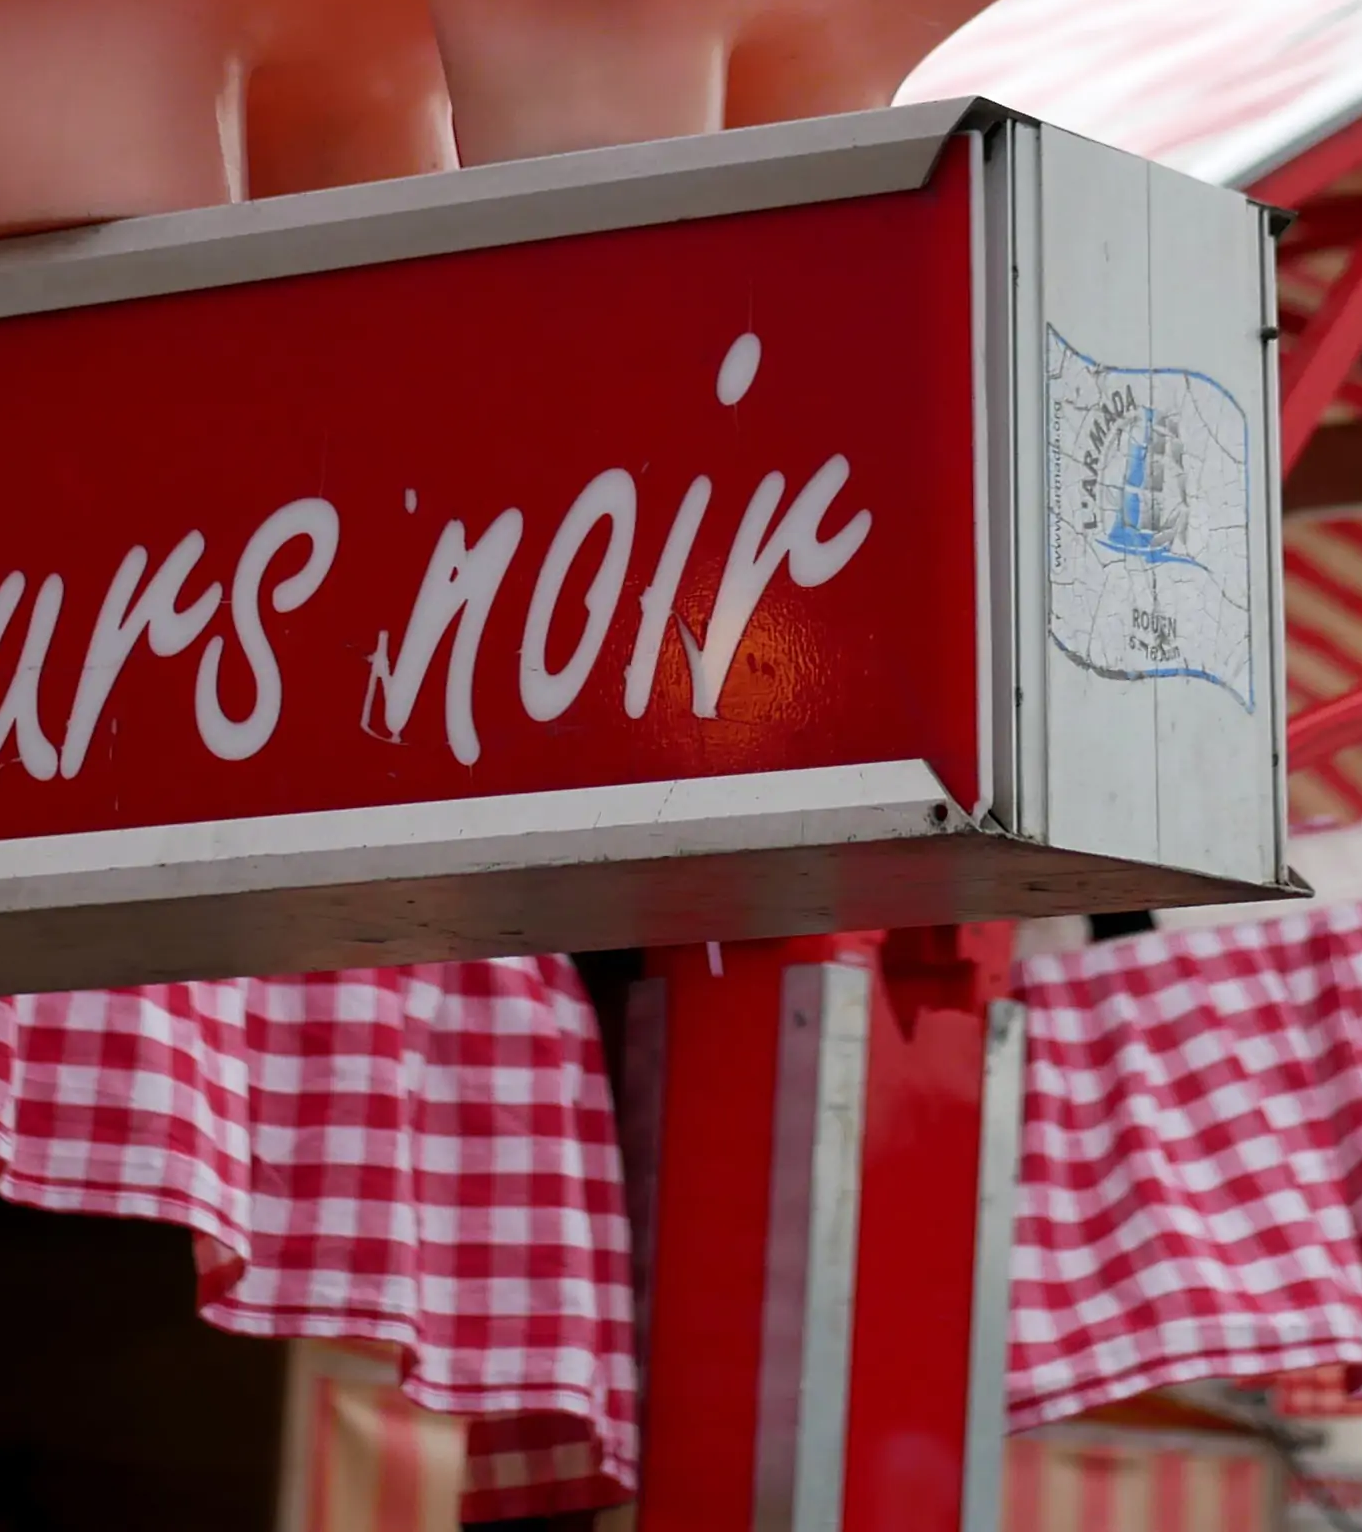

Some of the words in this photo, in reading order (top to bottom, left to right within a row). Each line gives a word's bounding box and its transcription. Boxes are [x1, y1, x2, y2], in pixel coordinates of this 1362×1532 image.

[1051, 400, 1063, 568] www.armada.org
[1081, 384, 1137, 530] L'ARMADA
[372, 333, 872, 765] noir
